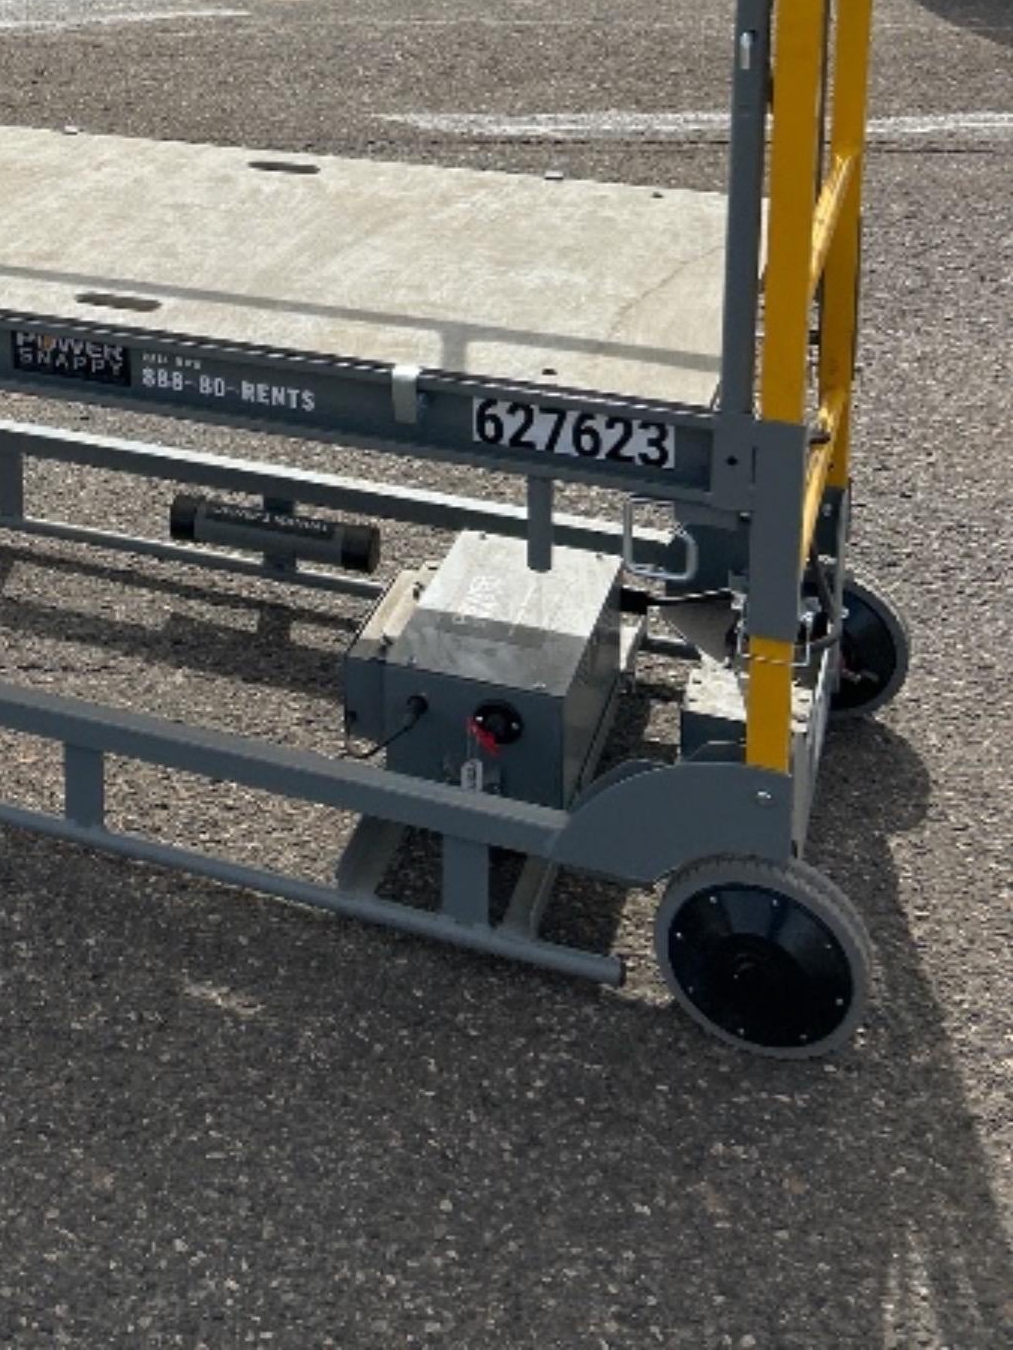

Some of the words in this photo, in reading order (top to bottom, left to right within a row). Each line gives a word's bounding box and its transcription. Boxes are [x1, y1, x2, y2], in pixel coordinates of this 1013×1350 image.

[16, 331, 123, 361] POWER
[18, 347, 123, 375] SNAPPY
[475, 399, 670, 468] 627623
